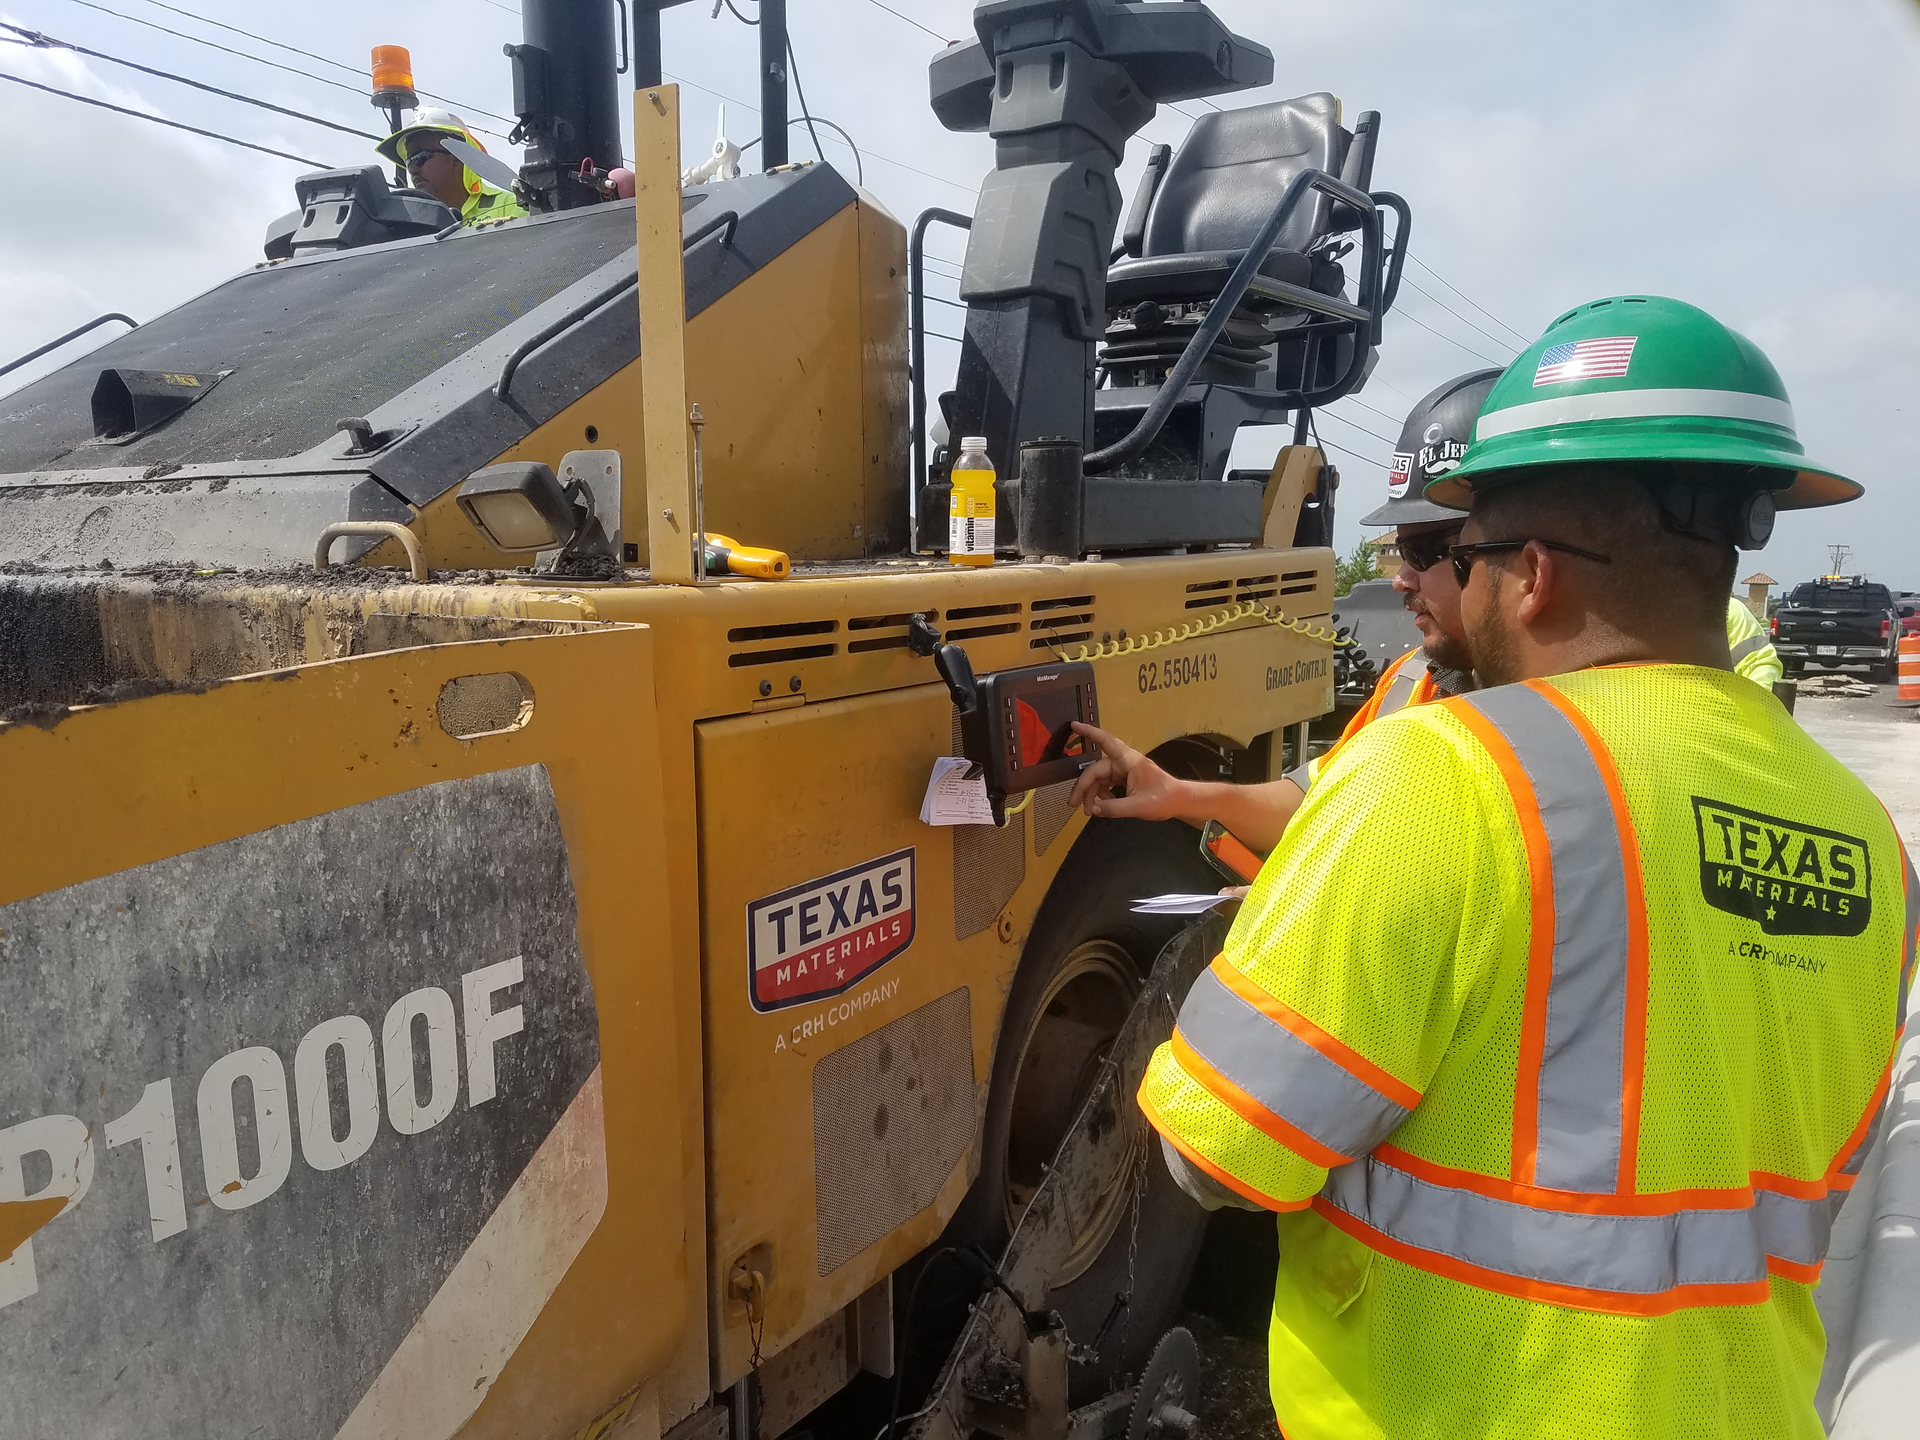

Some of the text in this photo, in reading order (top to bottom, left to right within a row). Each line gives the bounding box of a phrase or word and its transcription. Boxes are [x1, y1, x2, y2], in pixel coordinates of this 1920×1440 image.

[1418, 446, 1436, 468] EL
[1138, 652, 1217, 693] 62.550413
[1712, 814, 1856, 890] TEXAS
[768, 867, 903, 955] TEXAS
[776, 920, 901, 986] MATERIALS
[1728, 941, 1735, 956] A
[774, 977, 900, 1054] A CRH COMPANY
